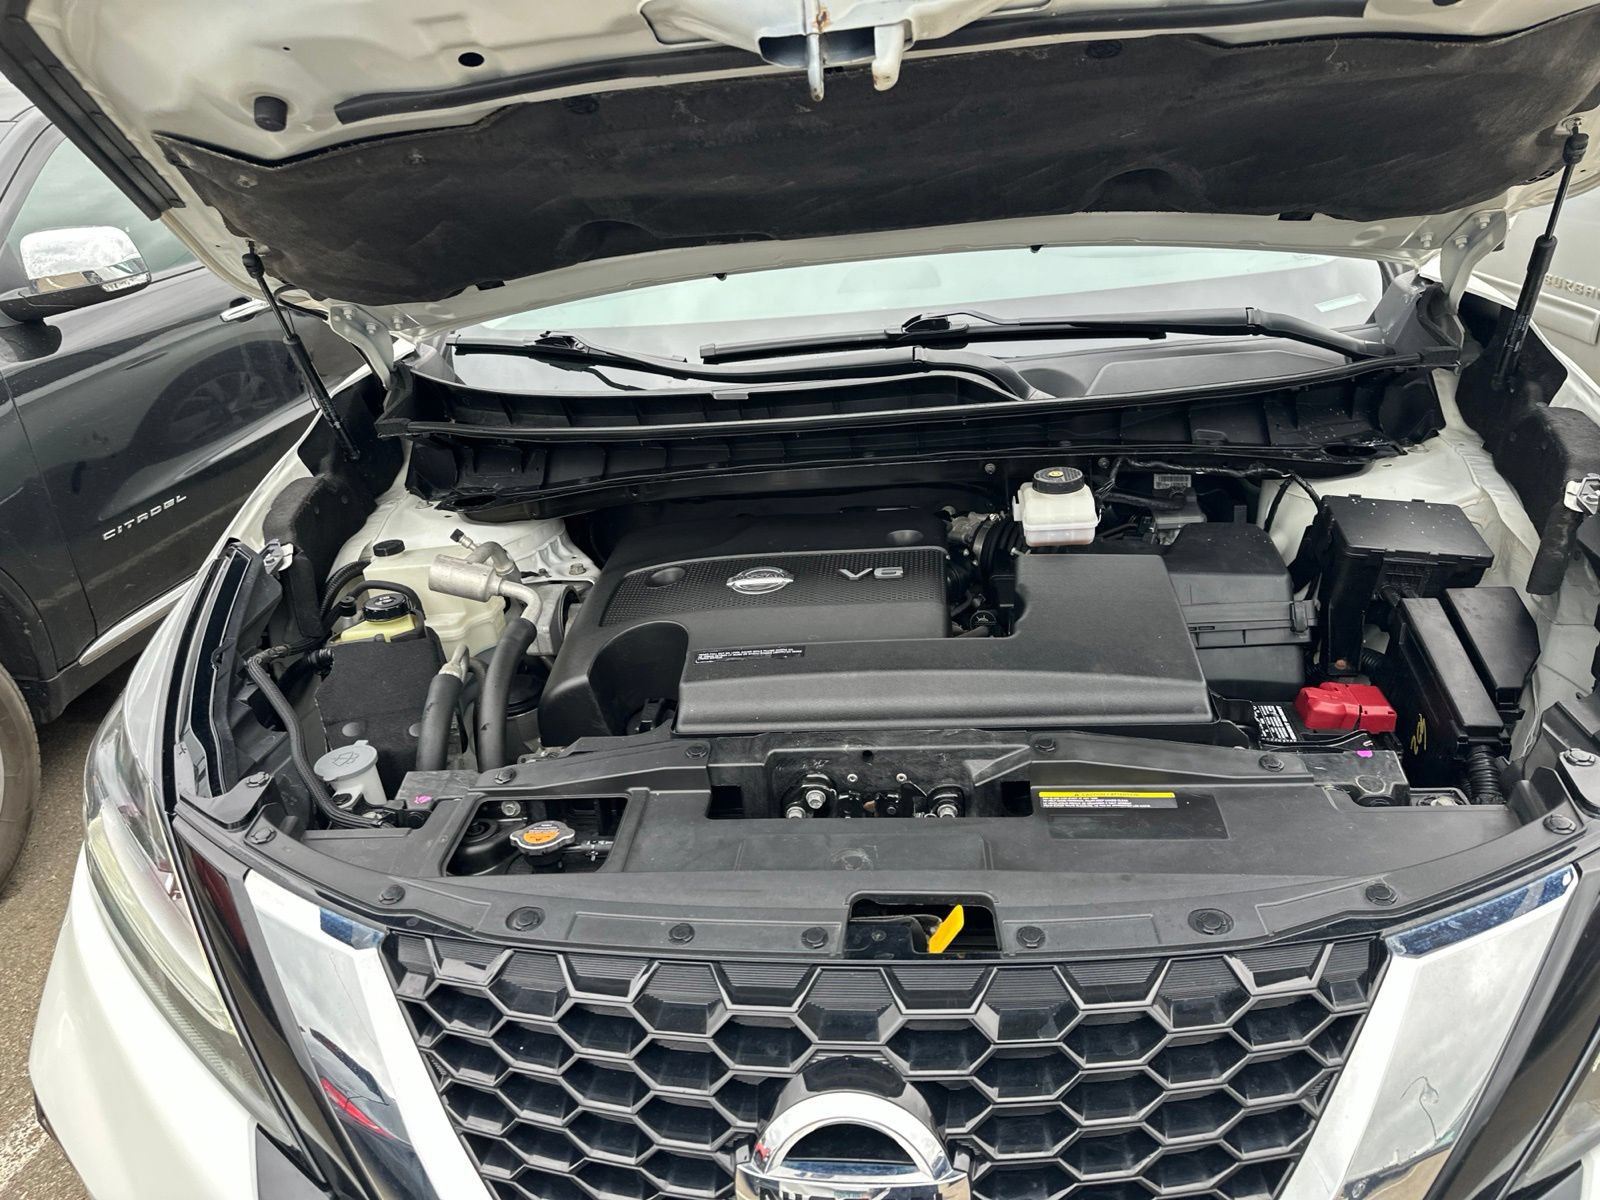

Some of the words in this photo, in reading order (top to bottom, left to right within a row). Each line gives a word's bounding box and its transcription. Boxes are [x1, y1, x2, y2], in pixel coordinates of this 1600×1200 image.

[1544, 272, 1600, 299] BURBA
[102, 494, 187, 541] CITADEL
[839, 566, 904, 581] V6
